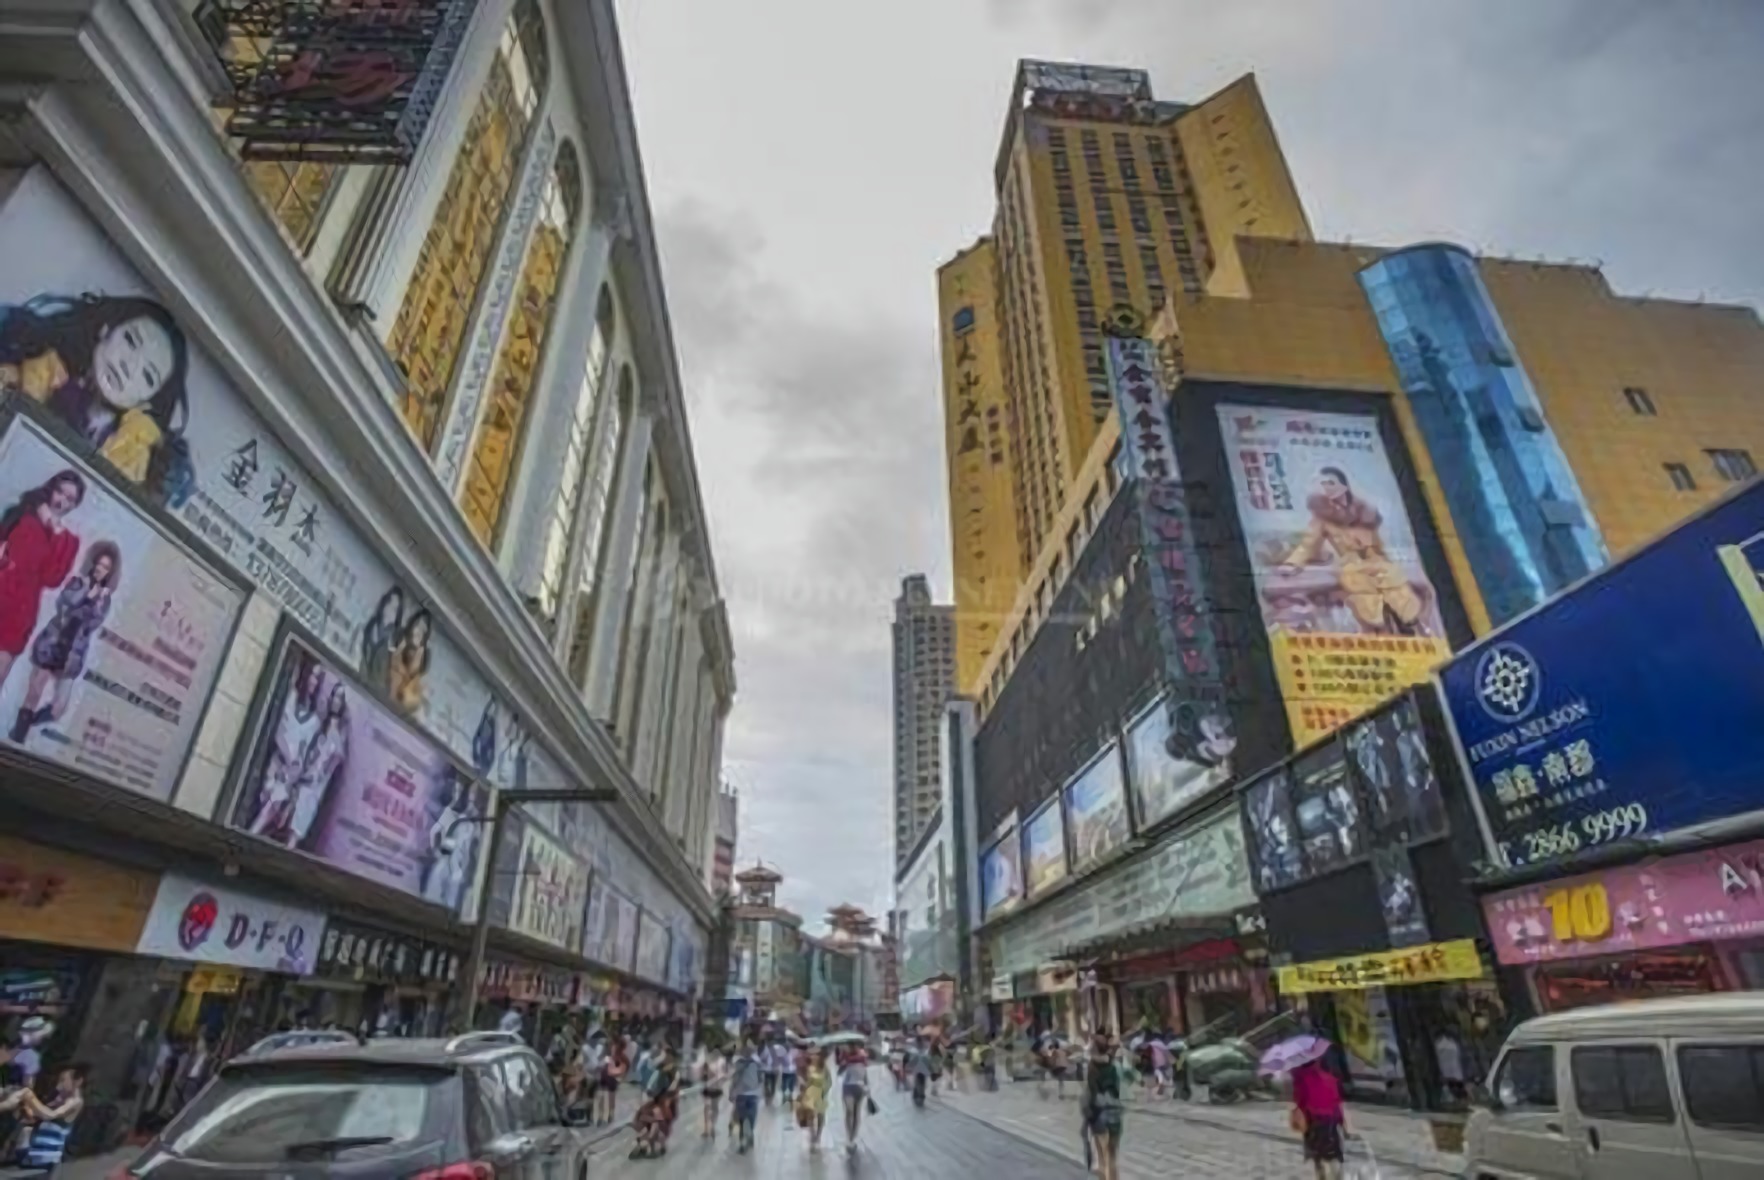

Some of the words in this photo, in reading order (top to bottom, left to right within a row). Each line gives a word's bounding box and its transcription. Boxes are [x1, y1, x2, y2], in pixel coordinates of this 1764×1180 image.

[219, 438, 320, 558] 金羽杰
[1580, 802, 1648, 846] 9999
[1542, 883, 1614, 943] 10
